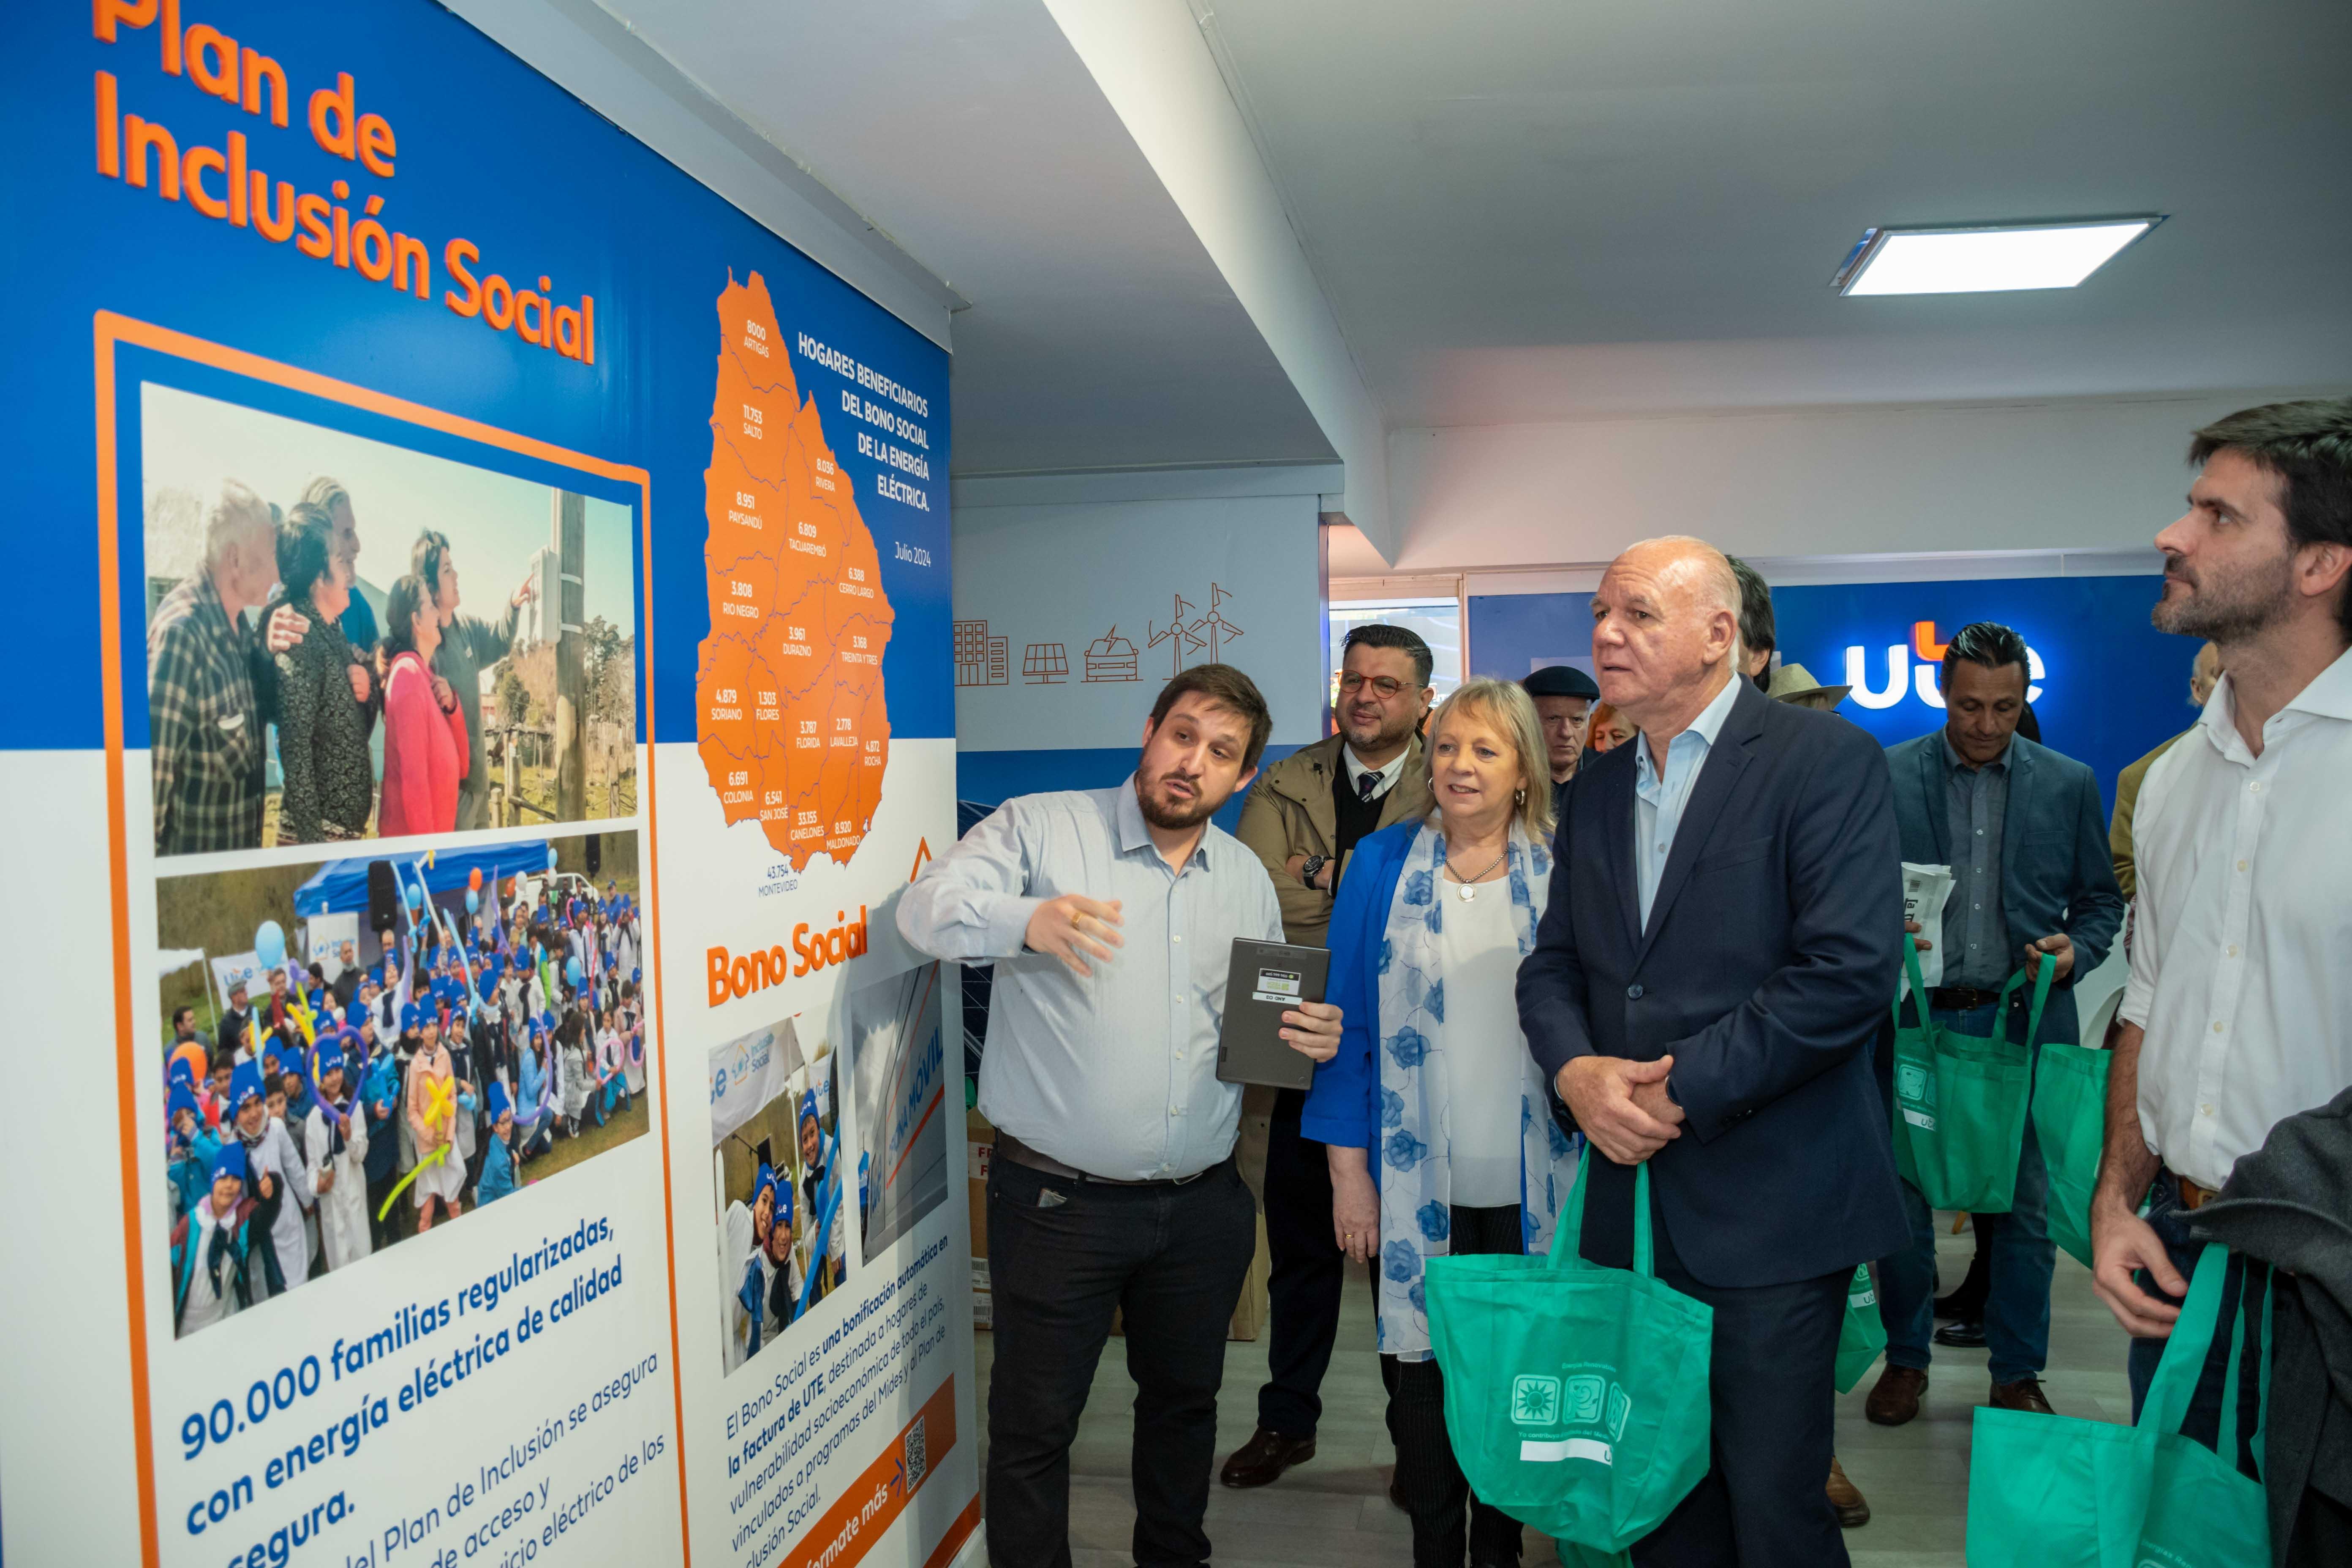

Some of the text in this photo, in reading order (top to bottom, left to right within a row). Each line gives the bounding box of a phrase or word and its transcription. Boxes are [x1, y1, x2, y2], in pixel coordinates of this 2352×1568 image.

[309, 72, 397, 177] de
[94, 70, 593, 365] Inclusión Social
[747, 320, 765, 341] 8000
[744, 336, 769, 358] ARTIGAS
[799, 332, 928, 418] HOGARES BENEFICIARIOS
[743, 404, 762, 425] 11.753
[842, 390, 928, 449] DEL BONO SOCIAL
[744, 423, 762, 440] SALTO
[858, 432, 929, 481] DE LA ENERGÍA
[817, 458, 834, 475] 8.036
[816, 476, 835, 492] RIVERA
[737, 492, 754, 509] 8.951
[878, 474, 929, 512] ELÉCTRICA.
[729, 510, 762, 530] PAYSANDÚ
[798, 522, 816, 538] 6.809
[789, 538, 826, 557] TACUAREMBÓ
[896, 542, 931, 567] Julio 2024
[849, 568, 864, 582] 6.388
[732, 581, 752, 598] 3.808
[839, 583, 874, 599] CERRO LARGO
[723, 602, 758, 618] RIO NEGRO
[789, 626, 805, 640] 3.961
[783, 643, 811, 656] DURAZNO
[853, 636, 867, 649] 3.168
[841, 651, 863, 664] TREINTA
[866, 654, 878, 665] TRES
[716, 689, 737, 704] 4.879
[759, 691, 776, 705] 1.303
[712, 708, 742, 721] SORIANO
[756, 709, 779, 721] FLORES
[800, 721, 816, 734] 3.787
[837, 718, 851, 730] 2.778
[797, 737, 820, 748] FLORIDA
[830, 736, 858, 747] LAVALLEJA
[866, 740, 879, 753] 4.872
[865, 756, 881, 766] ROCHA
[729, 771, 748, 786] 6.691
[724, 791, 753, 803] COLONIA
[765, 791, 782, 805] 6.541
[760, 804, 788, 821] SAN JOSÉ
[798, 811, 817, 825] 33.155
[791, 826, 824, 841] CANELONES
[835, 820, 852, 834] 8.920
[827, 835, 860, 850] MALDONADO
[768, 864, 788, 879] 43.754
[759, 879, 798, 898] MONTEVIDEO
[707, 904, 868, 1008] Bono Social
[181, 1213, 614, 1462] 90.000 familias regularizadas,
[727, 1411, 738, 1440] El
[742, 1388, 773, 1428] Bono
[776, 1352, 806, 1397] Social
[809, 1345, 820, 1367] es
[823, 1326, 841, 1355] una
[844, 1281, 895, 1338] bonificación
[898, 1247, 938, 1290] automática
[939, 1235, 947, 1252] en
[729, 1281, 927, 1478] la factura de UTE, destinada a hogares de
[185, 1255, 622, 1536] con energía eléctrica de calidad
[730, 1426, 811, 1514] vulnerabilidad
[814, 1353, 888, 1434] socioeconómica
[890, 1340, 900, 1361] de
[902, 1324, 919, 1352] todo
[920, 1312, 926, 1332] el
[928, 1296, 945, 1327] país,
[732, 1325, 945, 1552] vinculados a programas del Mides y al Plan de
[384, 1503, 440, 1562] Plan
[447, 1477, 475, 1519] de
[480, 1417, 564, 1494] Inclusión
[568, 1401, 587, 1432] se
[591, 1352, 658, 1413] asegura
[542, 1475, 613, 1546] eléctrico
[618, 1452, 638, 1486] de
[642, 1433, 664, 1469] los
[787, 1483, 821, 1533] Social.
[862, 1483, 887, 1526] más
[227, 1486, 356, 1568] segura.
[430, 1475, 552, 1568] de acceso y
